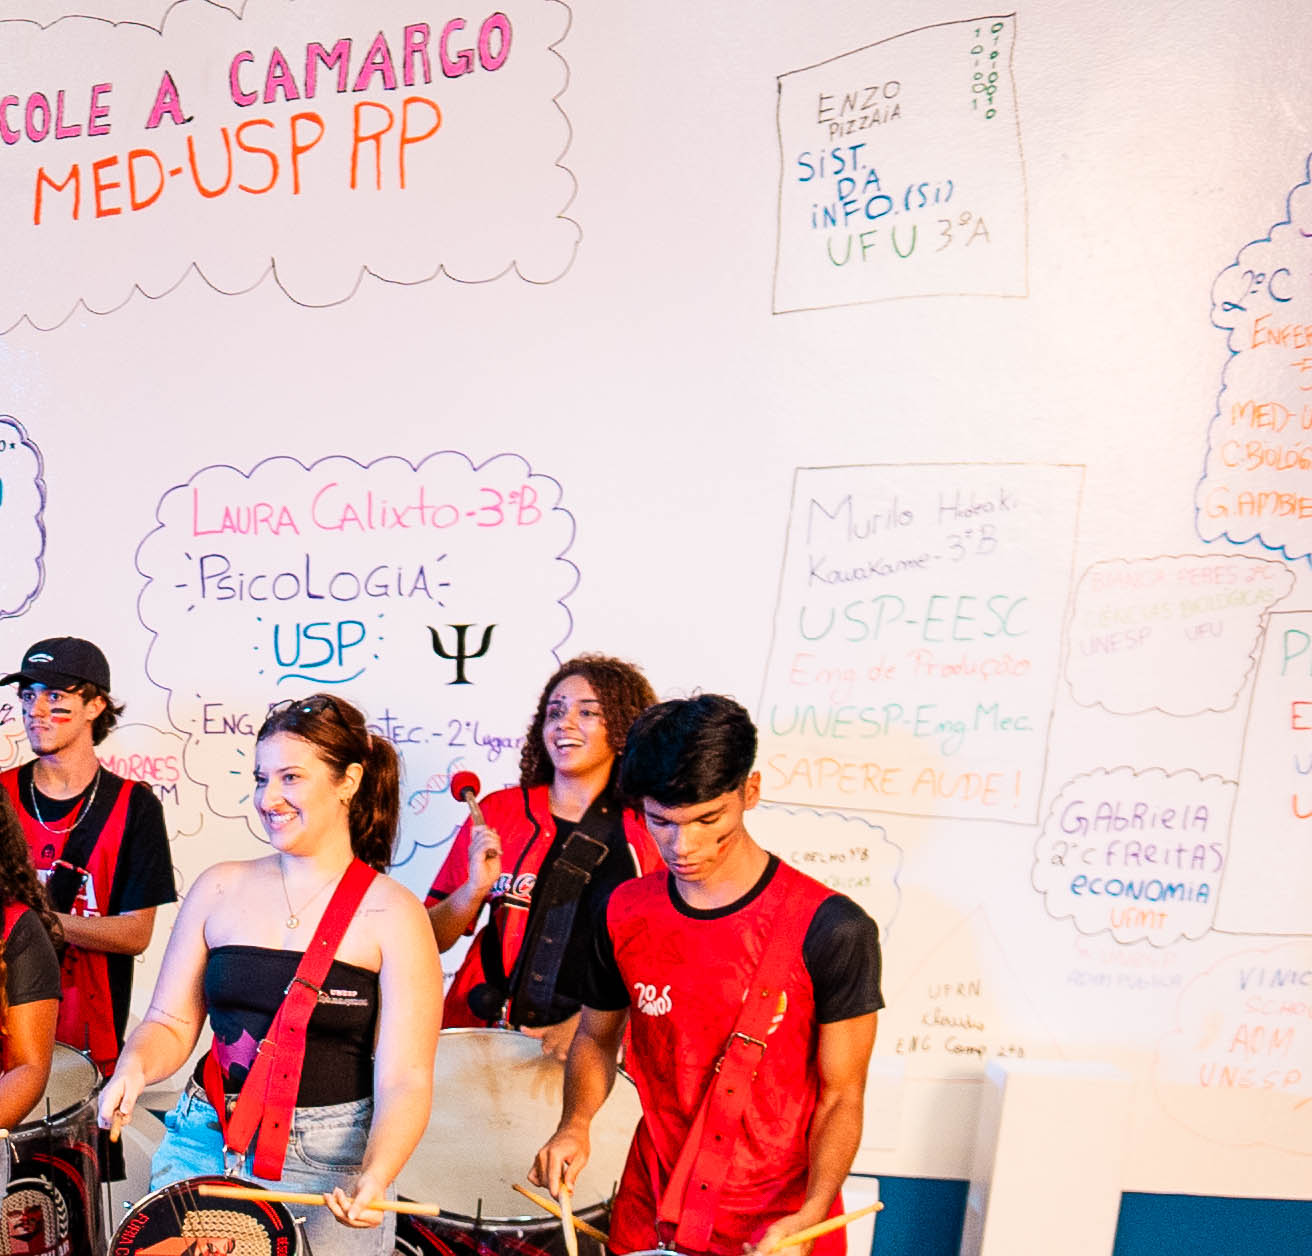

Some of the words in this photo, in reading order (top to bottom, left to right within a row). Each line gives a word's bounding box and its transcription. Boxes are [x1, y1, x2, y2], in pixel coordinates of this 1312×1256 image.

[229, 12, 513, 109] CAMARGO
[818, 81, 901, 124] ENZO
[32, 112, 326, 226] MED-USP
[349, 96, 443, 191] RP
[827, 224, 917, 266] UFU
[192, 487, 301, 537] LAURA
[799, 594, 1029, 642] USP-EESC
[274, 620, 366, 668] USP
[767, 753, 903, 797] SAPERE
